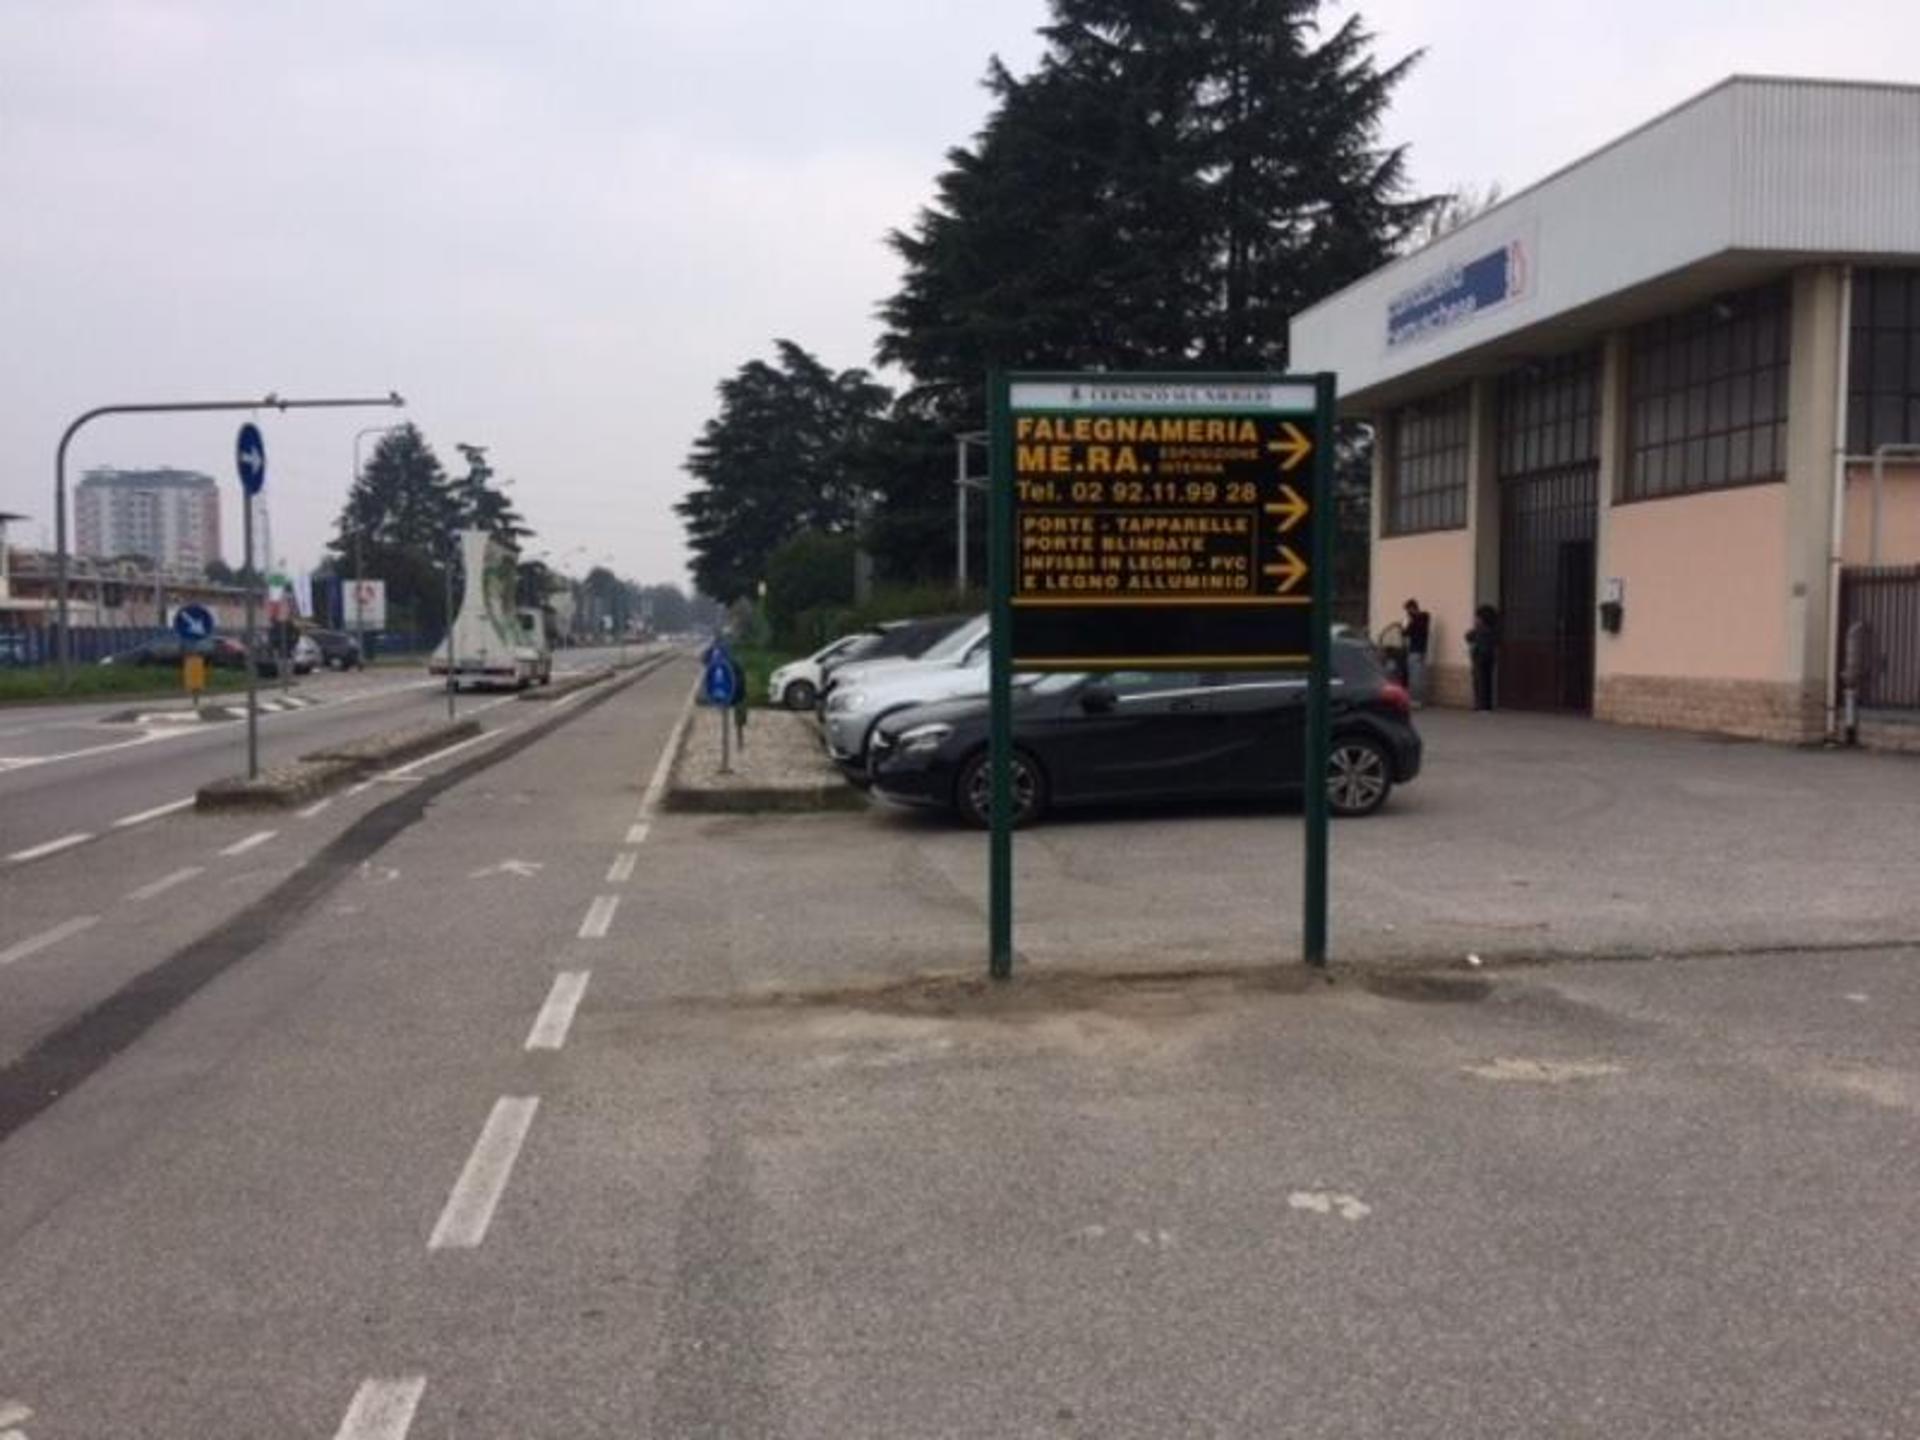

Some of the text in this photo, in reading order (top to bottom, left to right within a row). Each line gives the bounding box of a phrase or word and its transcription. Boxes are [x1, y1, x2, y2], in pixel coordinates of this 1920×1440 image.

[1016, 418, 1258, 442] FALEGNAMERIA
[1016, 445, 1151, 473] ME.RA.
[1017, 481, 1258, 502] Tel. 02 92.11.99 28
[1022, 517, 1094, 532] PORTE
[1115, 517, 1248, 532] TAPPARELLE
[1022, 536, 1205, 551] PORTE BLINDATE
[1101, 555, 1121, 569] IN
[1127, 555, 1192, 569] LEGNO
[1210, 556, 1248, 570] PVC
[1023, 574, 1249, 589] E LEGNO ALLUMINIO
